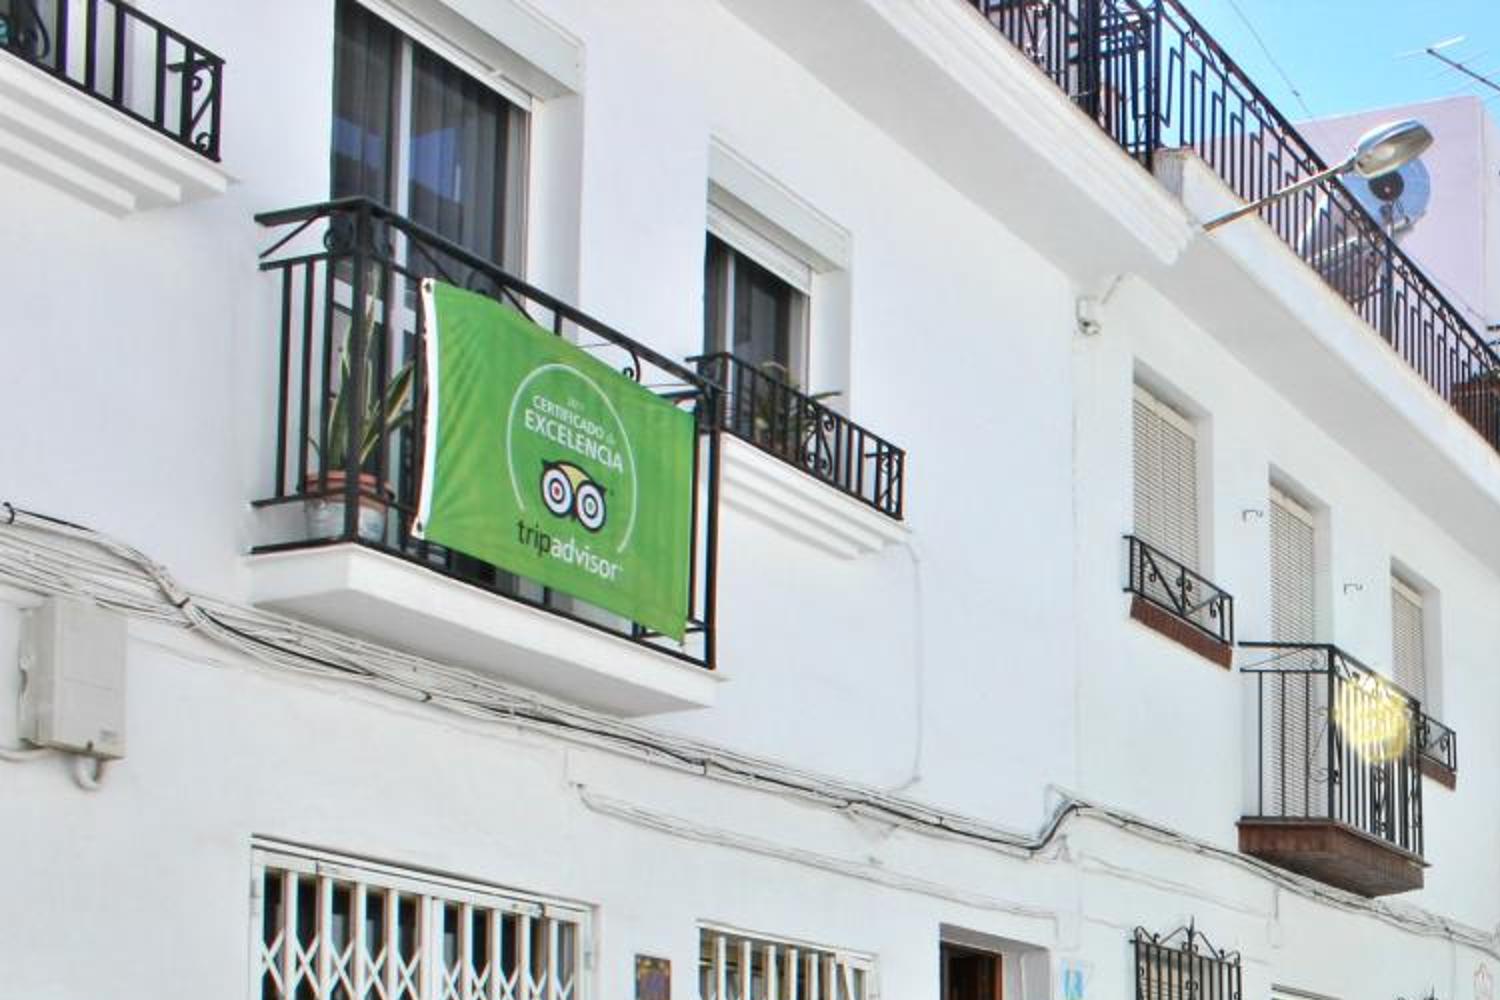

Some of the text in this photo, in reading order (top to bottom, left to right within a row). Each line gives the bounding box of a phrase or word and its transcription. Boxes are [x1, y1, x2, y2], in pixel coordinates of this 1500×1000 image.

[525, 408, 623, 473] EXCELENCIA
[533, 395, 604, 439] CERTIFICADO
[518, 519, 619, 581] tripadvisor
